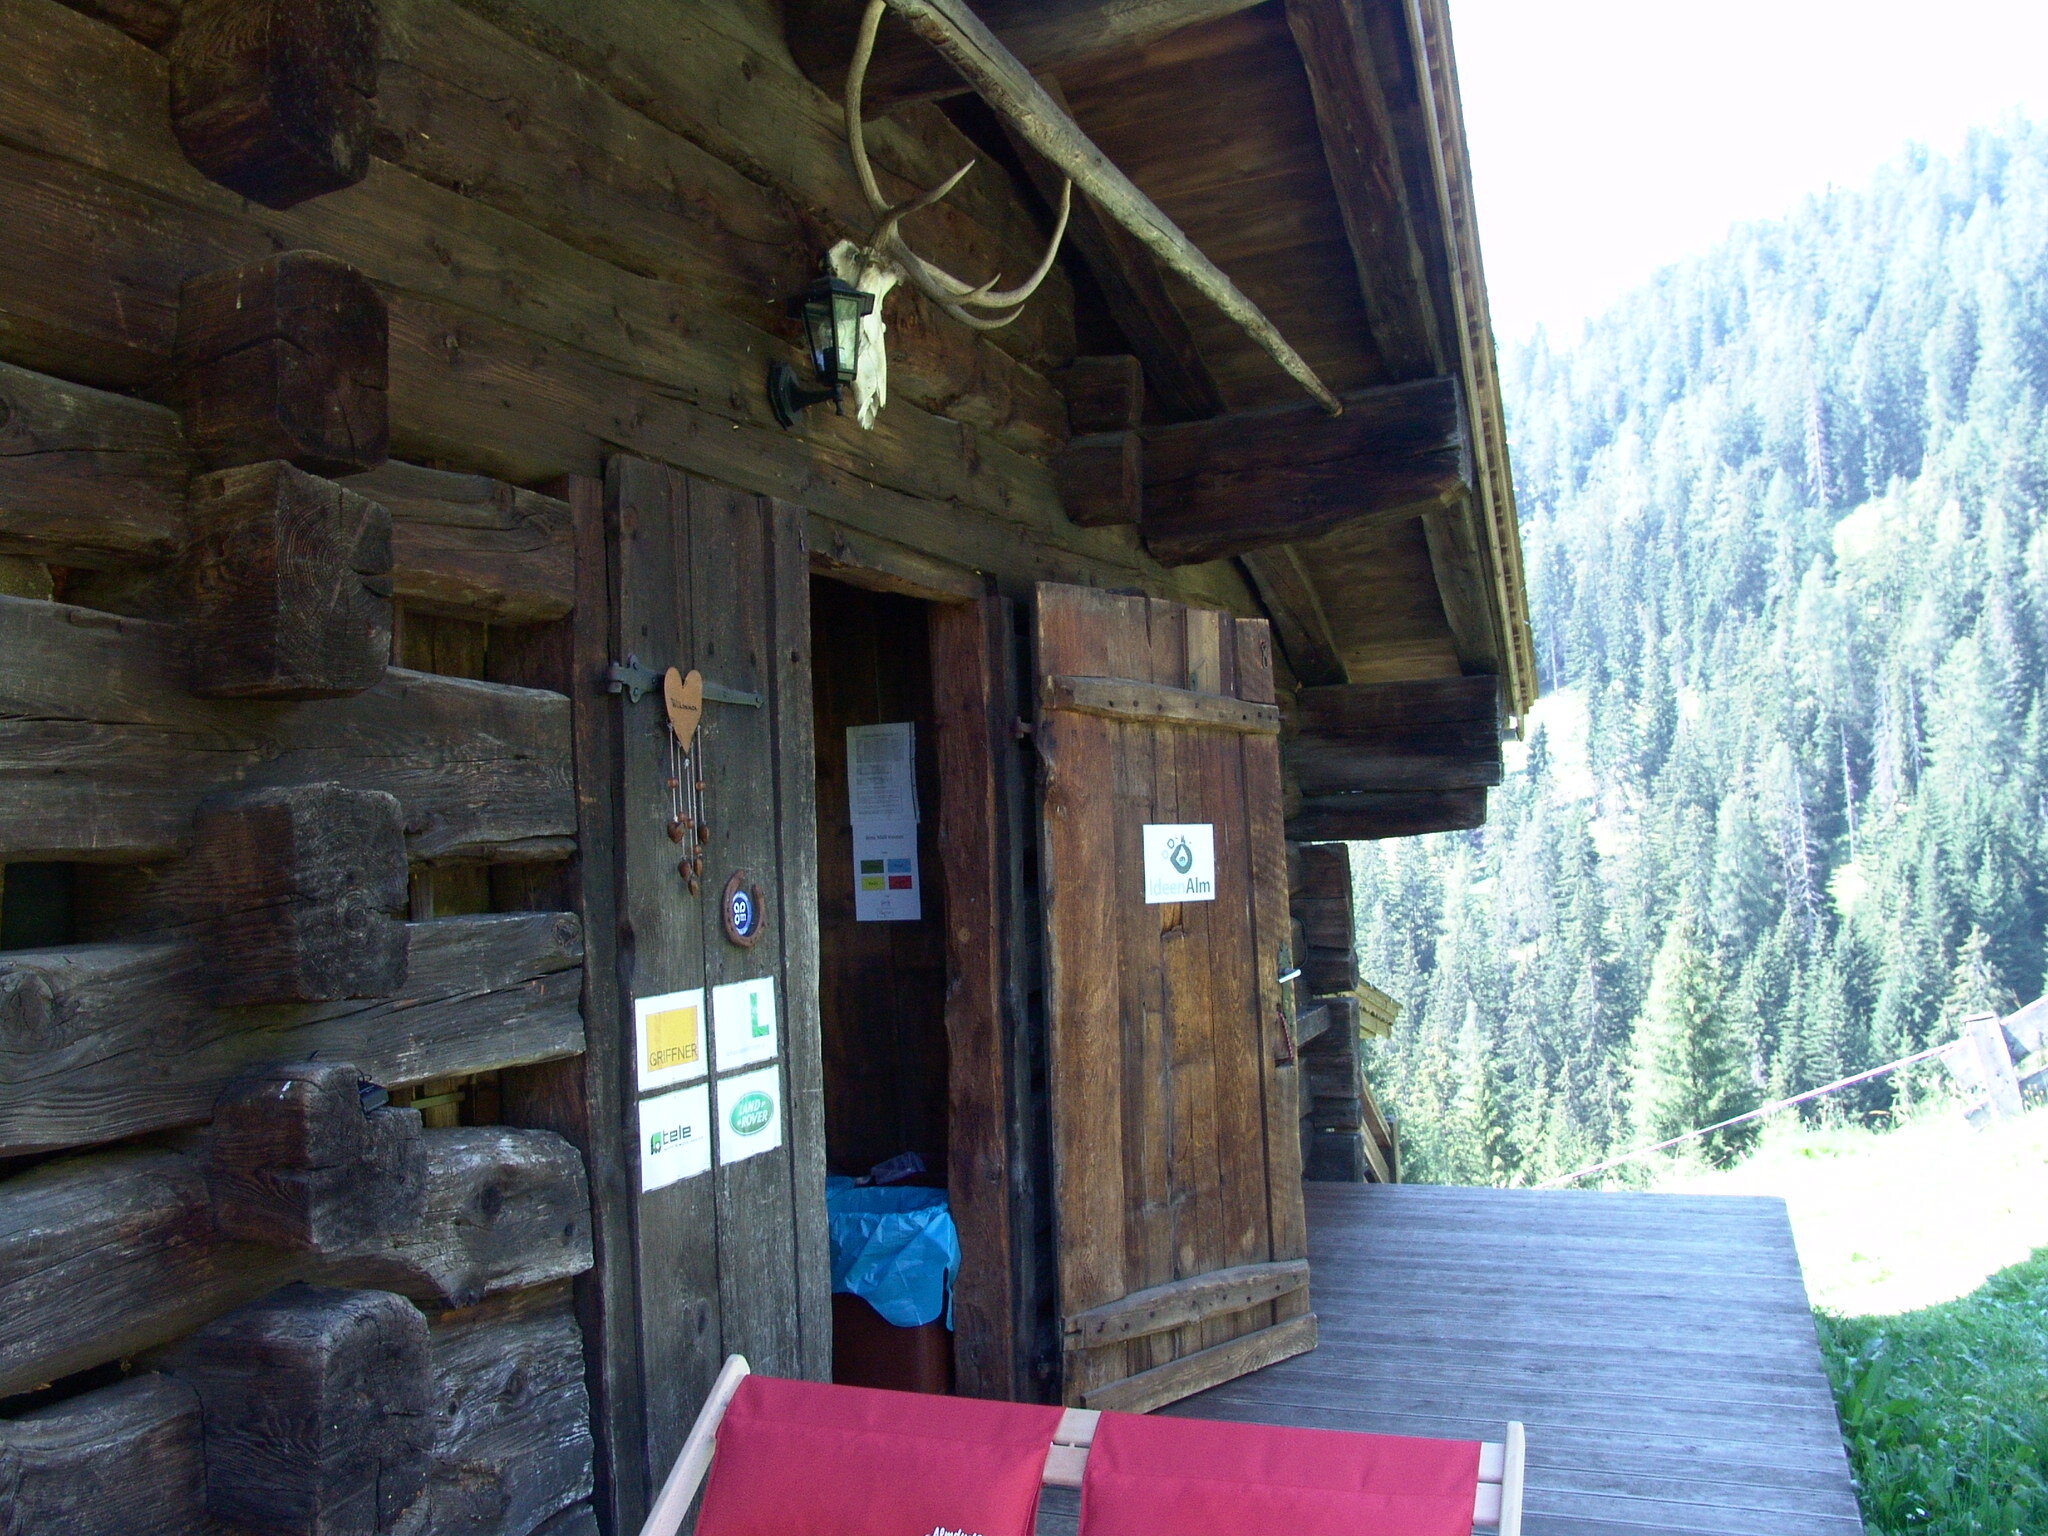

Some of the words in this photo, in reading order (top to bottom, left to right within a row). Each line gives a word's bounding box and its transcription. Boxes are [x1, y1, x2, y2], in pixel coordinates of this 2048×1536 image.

[1149, 877, 1211, 896] IdeenAlm
[750, 992, 770, 1038] L
[649, 1043, 698, 1067] GRIFFNER
[739, 1099, 761, 1116] LAND
[741, 1109, 768, 1128] ROVER
[662, 1124, 692, 1145] tele
